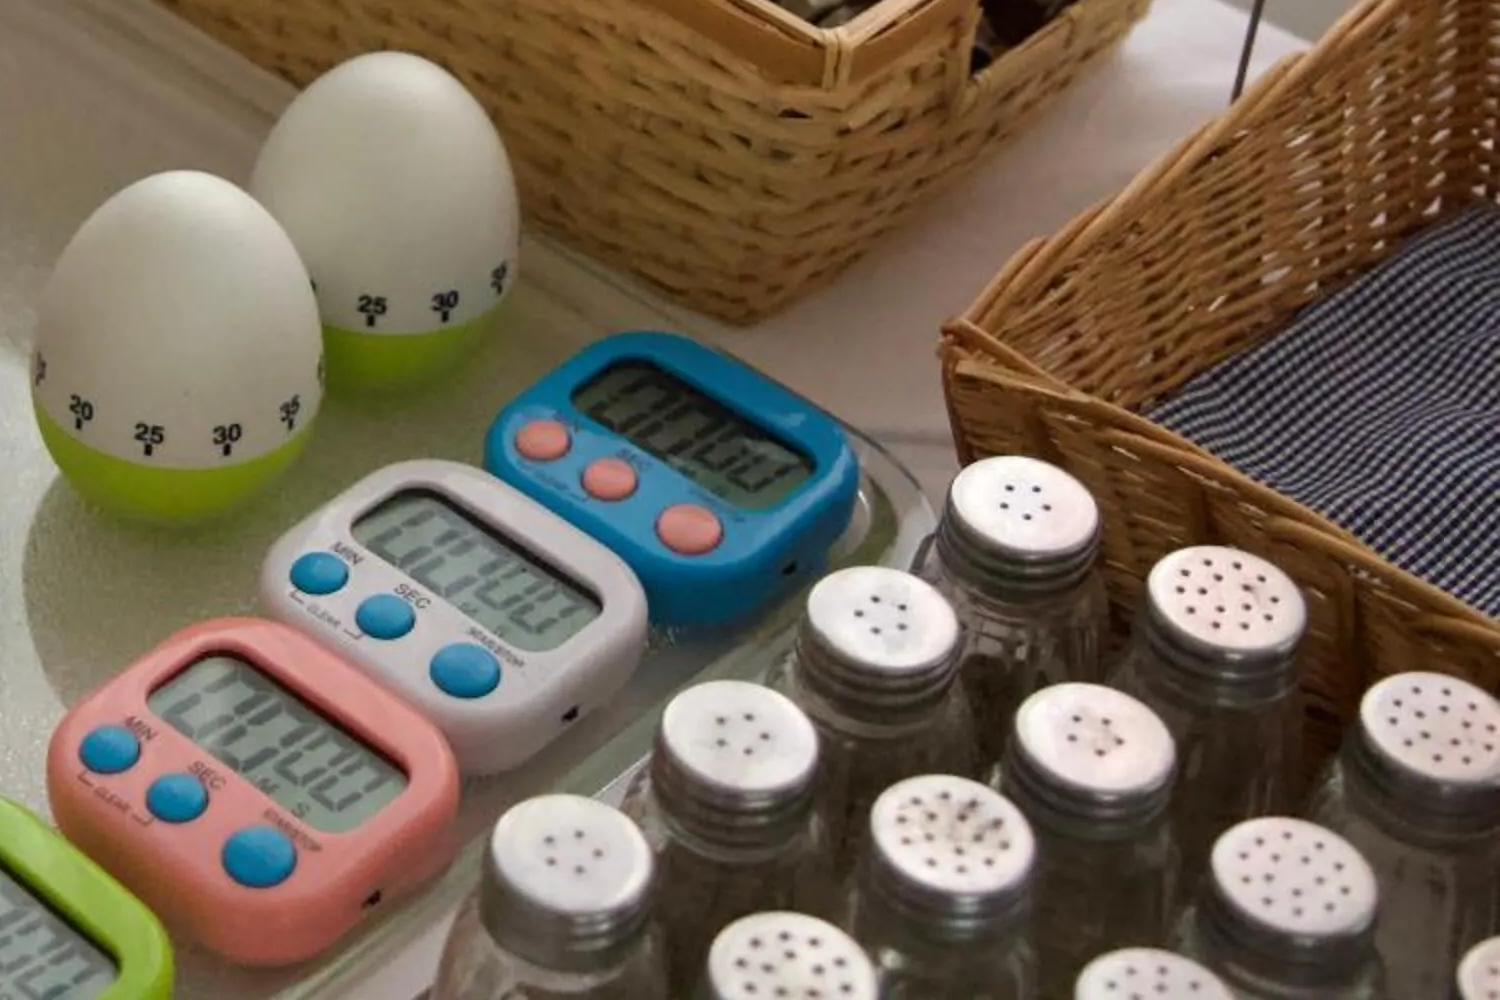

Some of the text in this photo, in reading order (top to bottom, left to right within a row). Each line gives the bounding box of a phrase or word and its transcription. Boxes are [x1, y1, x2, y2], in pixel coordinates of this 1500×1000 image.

[357, 290, 460, 315] 25 30
[69, 394, 301, 446] 20 25 30 35
[330, 540, 364, 568] MIN
[394, 582, 432, 610] SEC
[124, 715, 159, 743] MIN
[187, 760, 228, 793] SEC
